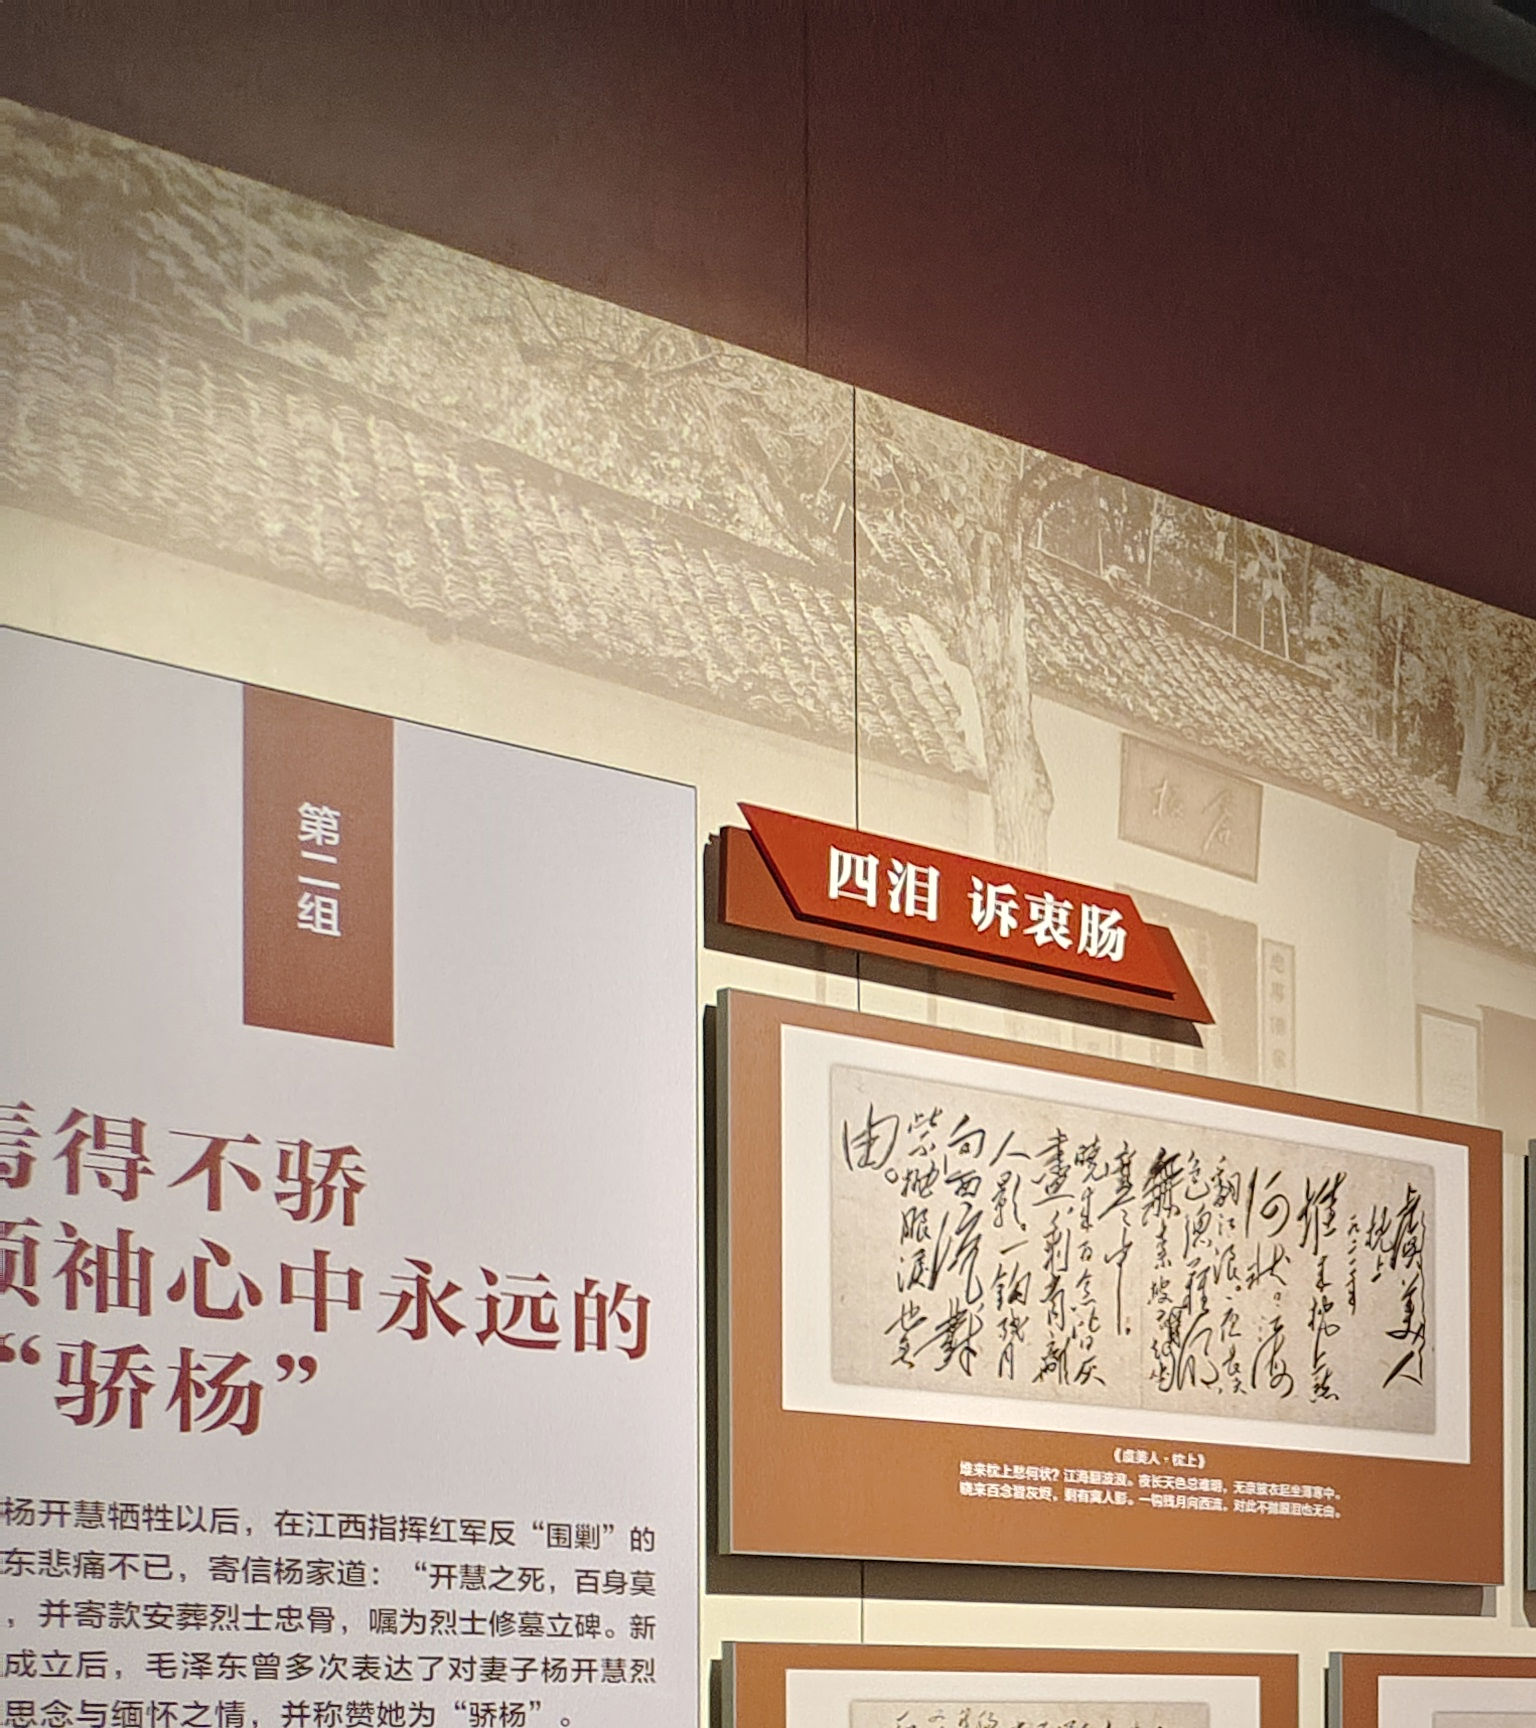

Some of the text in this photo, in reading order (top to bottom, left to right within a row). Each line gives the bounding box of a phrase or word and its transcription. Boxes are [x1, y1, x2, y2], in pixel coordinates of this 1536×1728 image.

[296, 801, 342, 938] 第二组
[828, 846, 1127, 962] 四泪 诉衷肠
[0, 1331, 319, 1436] “骄杨”
[0, 1547, 657, 1598] 东悲痛不已，寄信杨家道：“开慧之死，百身莫
[0, 1648, 657, 1686] 成立后，毛泽东曾多次表达了对妻子杨开慧烈
